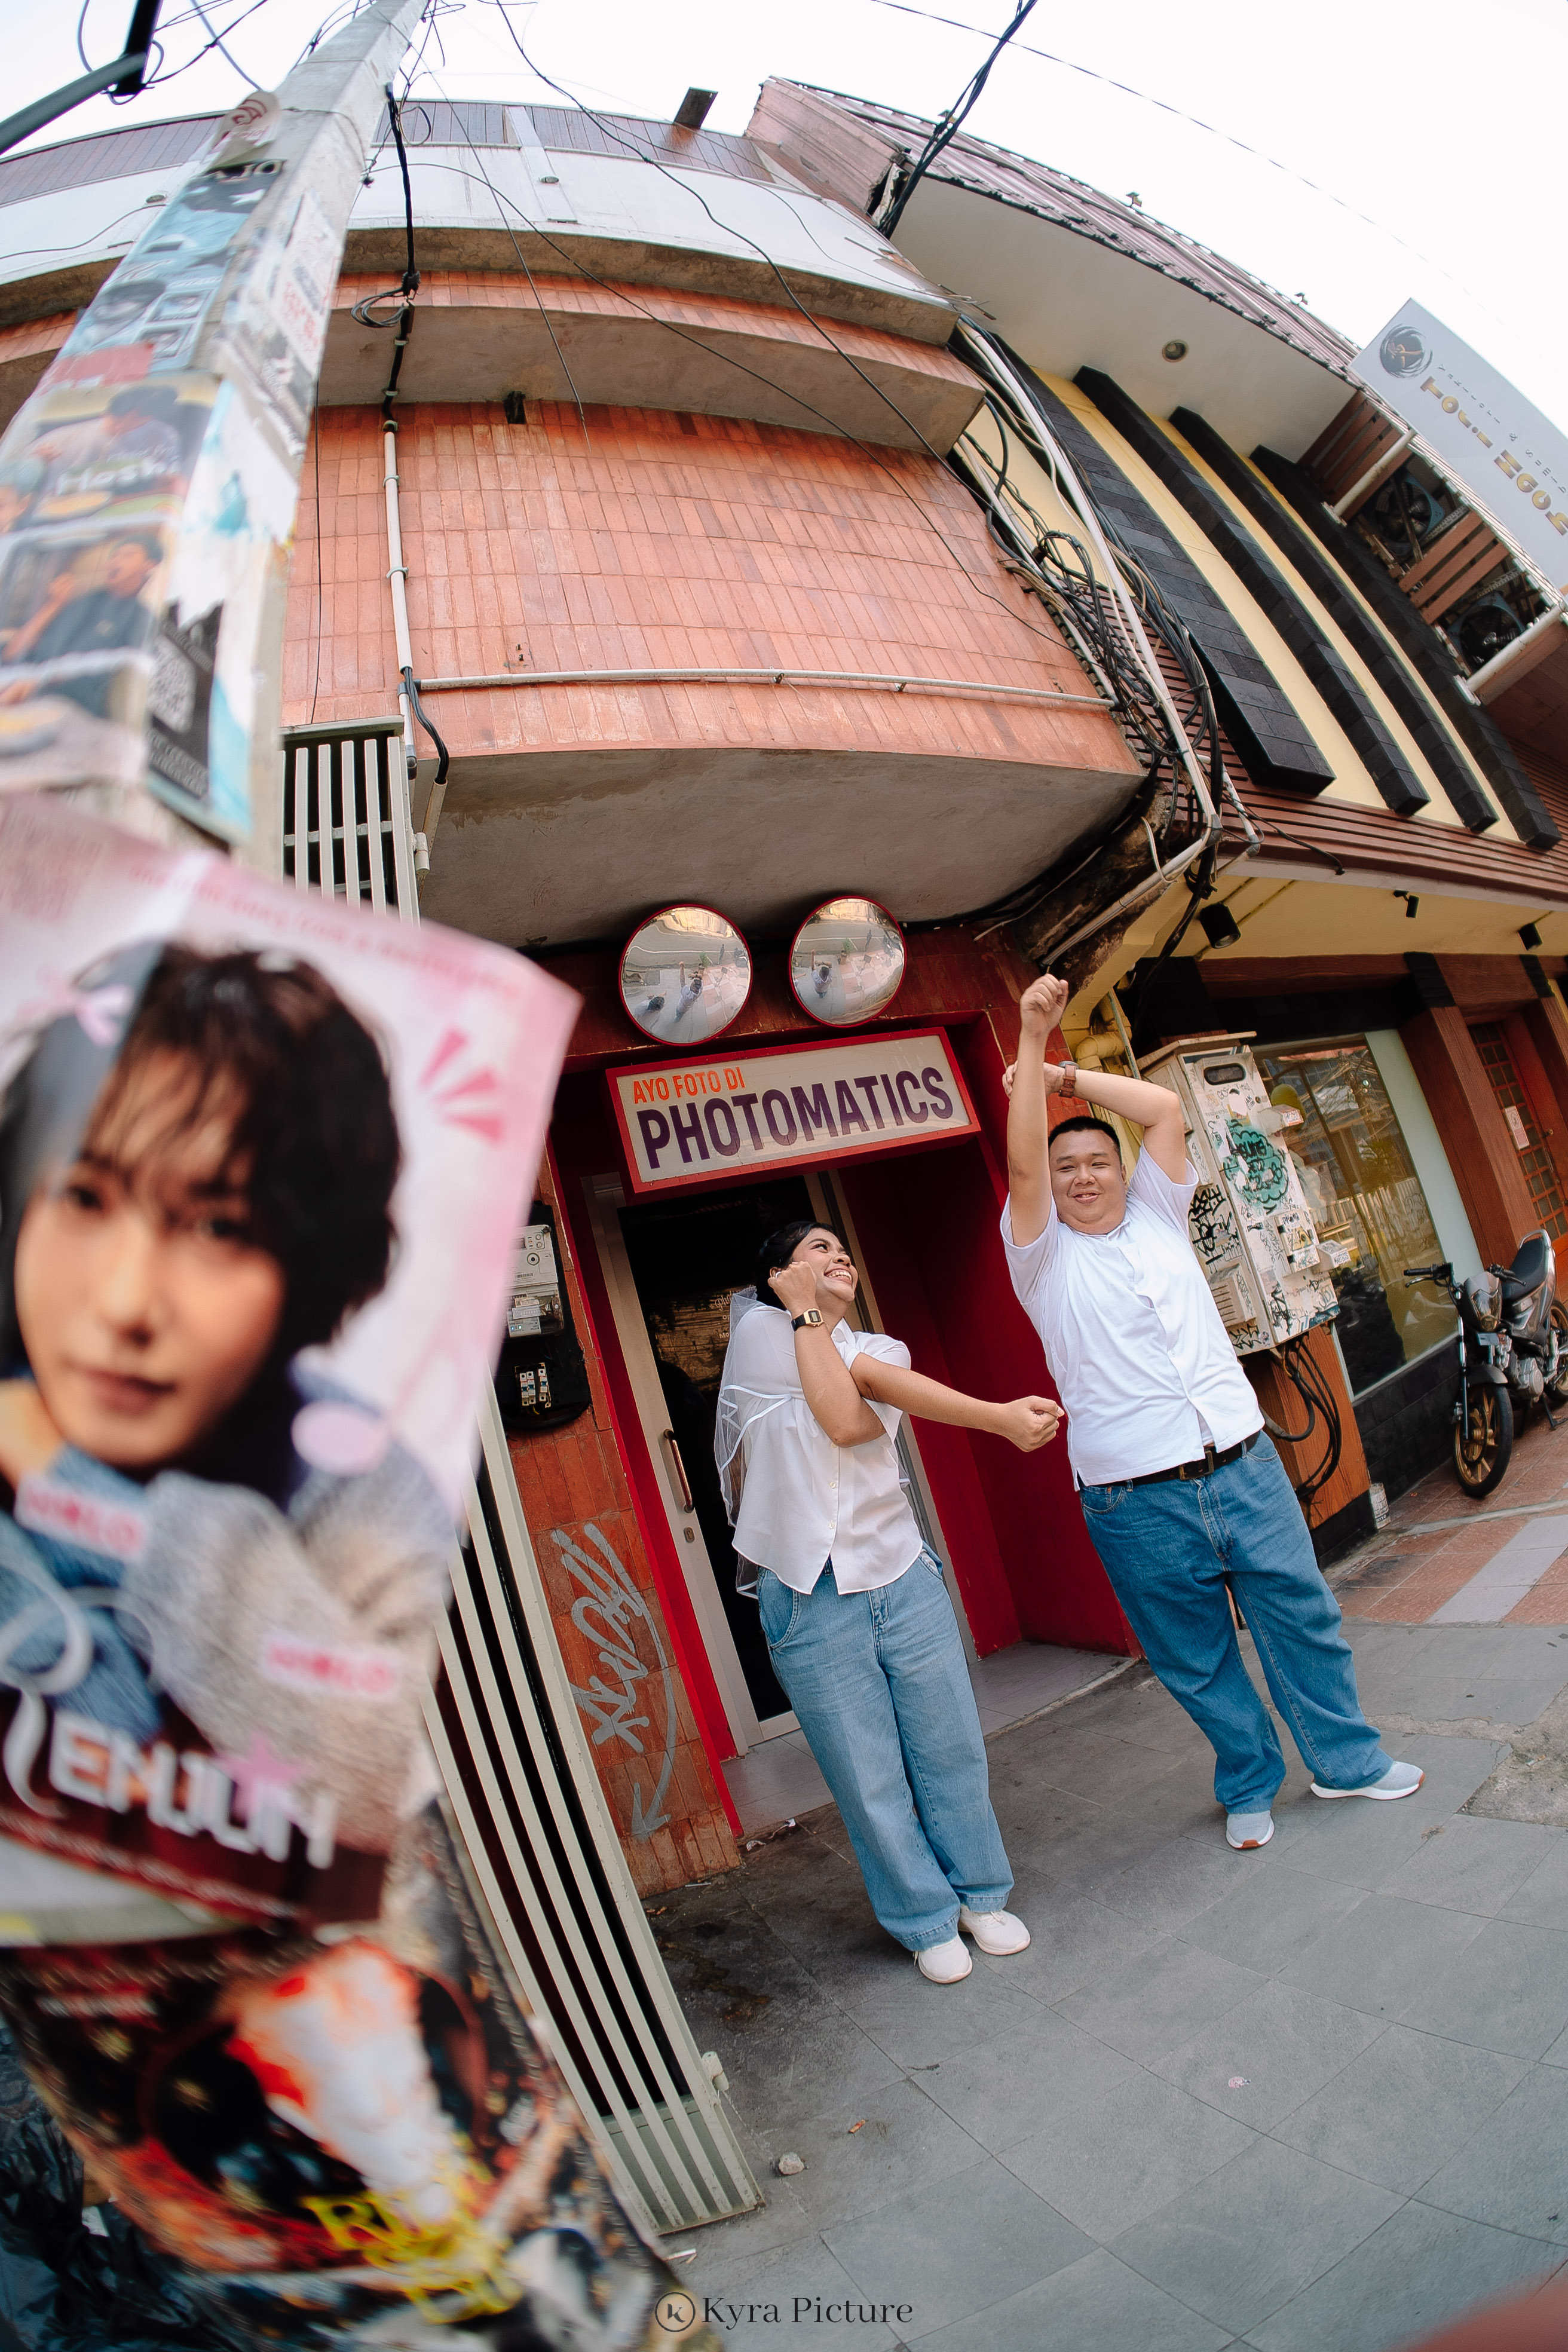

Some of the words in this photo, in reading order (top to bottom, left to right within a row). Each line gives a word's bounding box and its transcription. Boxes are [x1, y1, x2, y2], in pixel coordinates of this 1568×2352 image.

[1419, 375, 1493, 448] Tori
[1509, 432, 1518, 442] &
[633, 1077, 670, 1104] AYO
[673, 1070, 722, 1098] FOTO
[725, 1066, 746, 1090] DI
[636, 1067, 954, 1170] PHOTOMATICS
